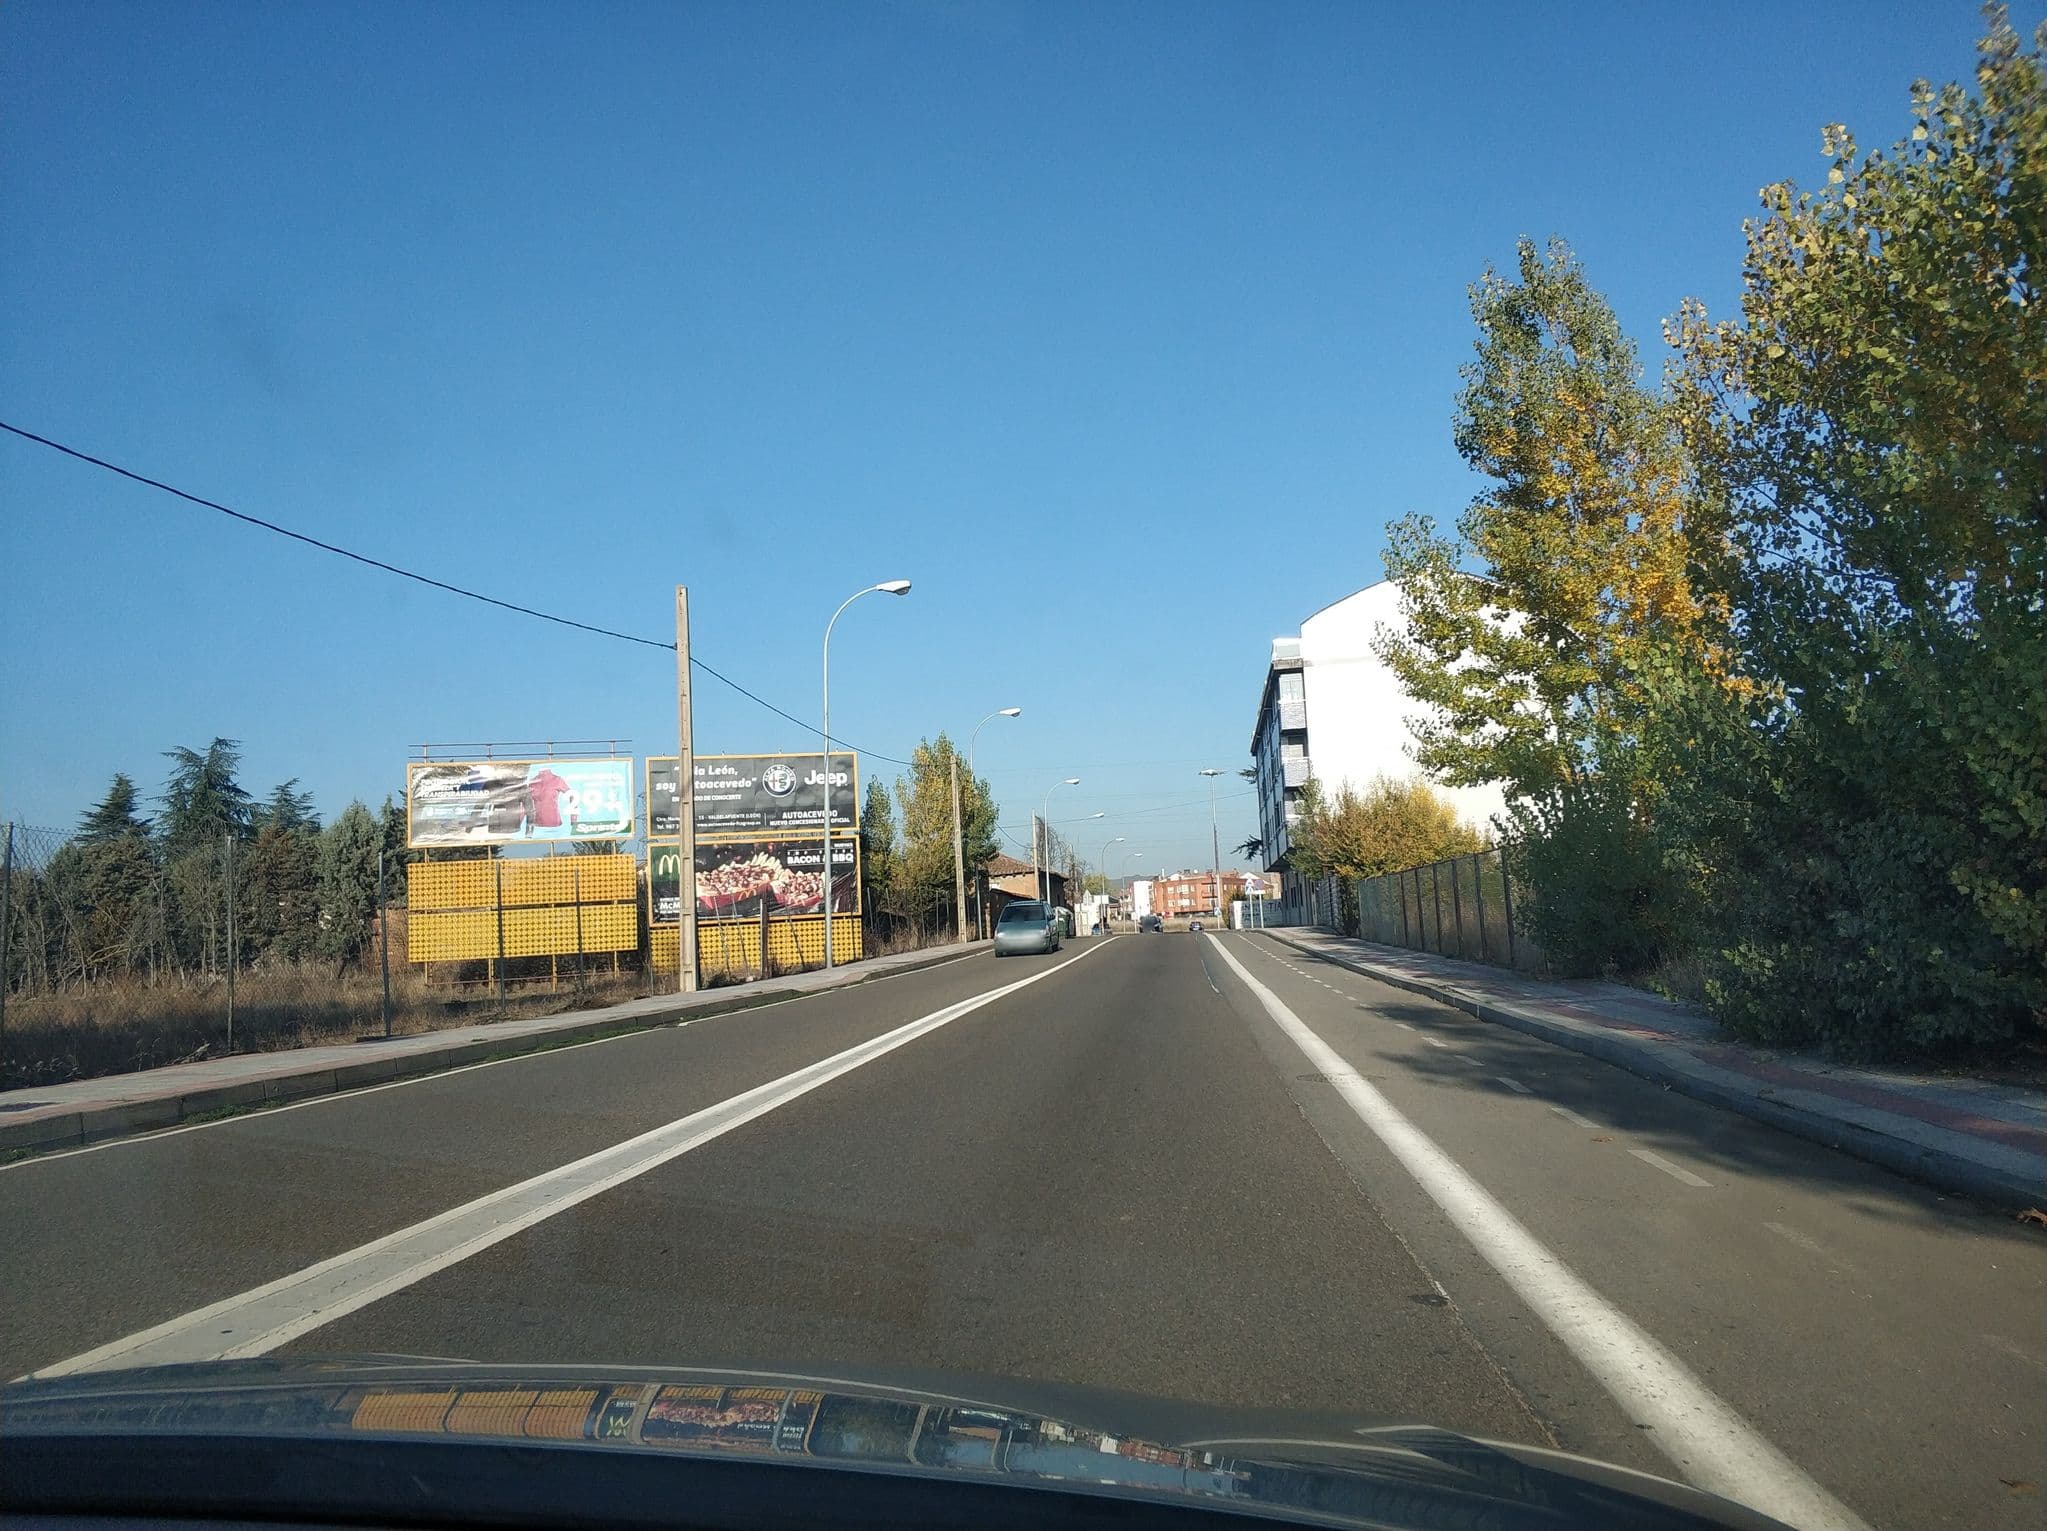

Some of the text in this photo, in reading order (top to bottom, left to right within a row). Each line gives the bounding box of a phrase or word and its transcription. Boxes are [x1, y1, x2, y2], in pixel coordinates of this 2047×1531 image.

[708, 764, 738, 776] León,
[655, 777, 757, 793] soy toacevedo"
[804, 770, 848, 789] Jeep
[787, 854, 821, 865] BACON
[831, 853, 854, 864] BBQ
